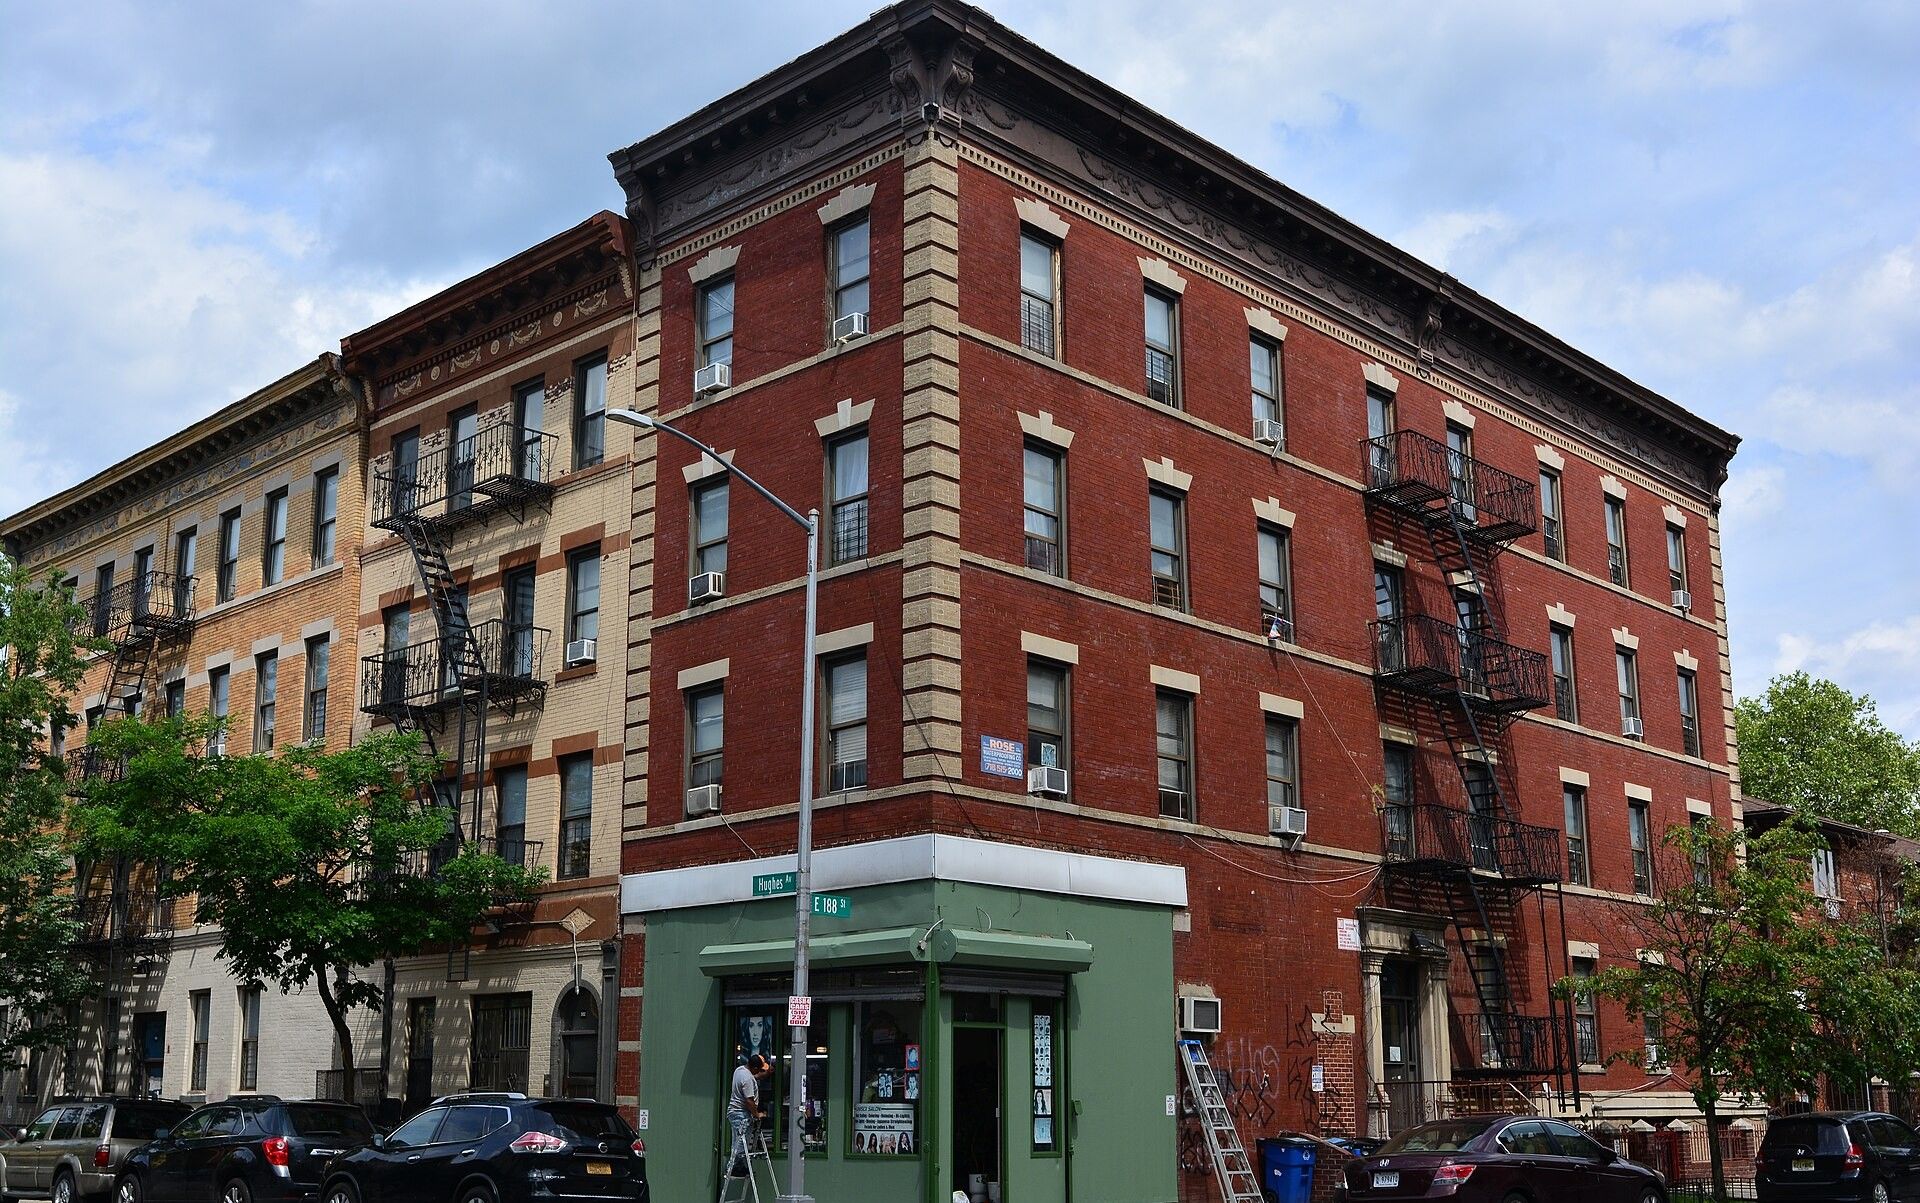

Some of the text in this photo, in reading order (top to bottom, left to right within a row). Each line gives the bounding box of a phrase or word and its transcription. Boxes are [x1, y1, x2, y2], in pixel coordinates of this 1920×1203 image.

[989, 739, 1015, 752] ROSE
[758, 874, 792, 894] Hughes Av
[814, 896, 847, 914] E 188 St
[790, 1003, 810, 1011] CARS
